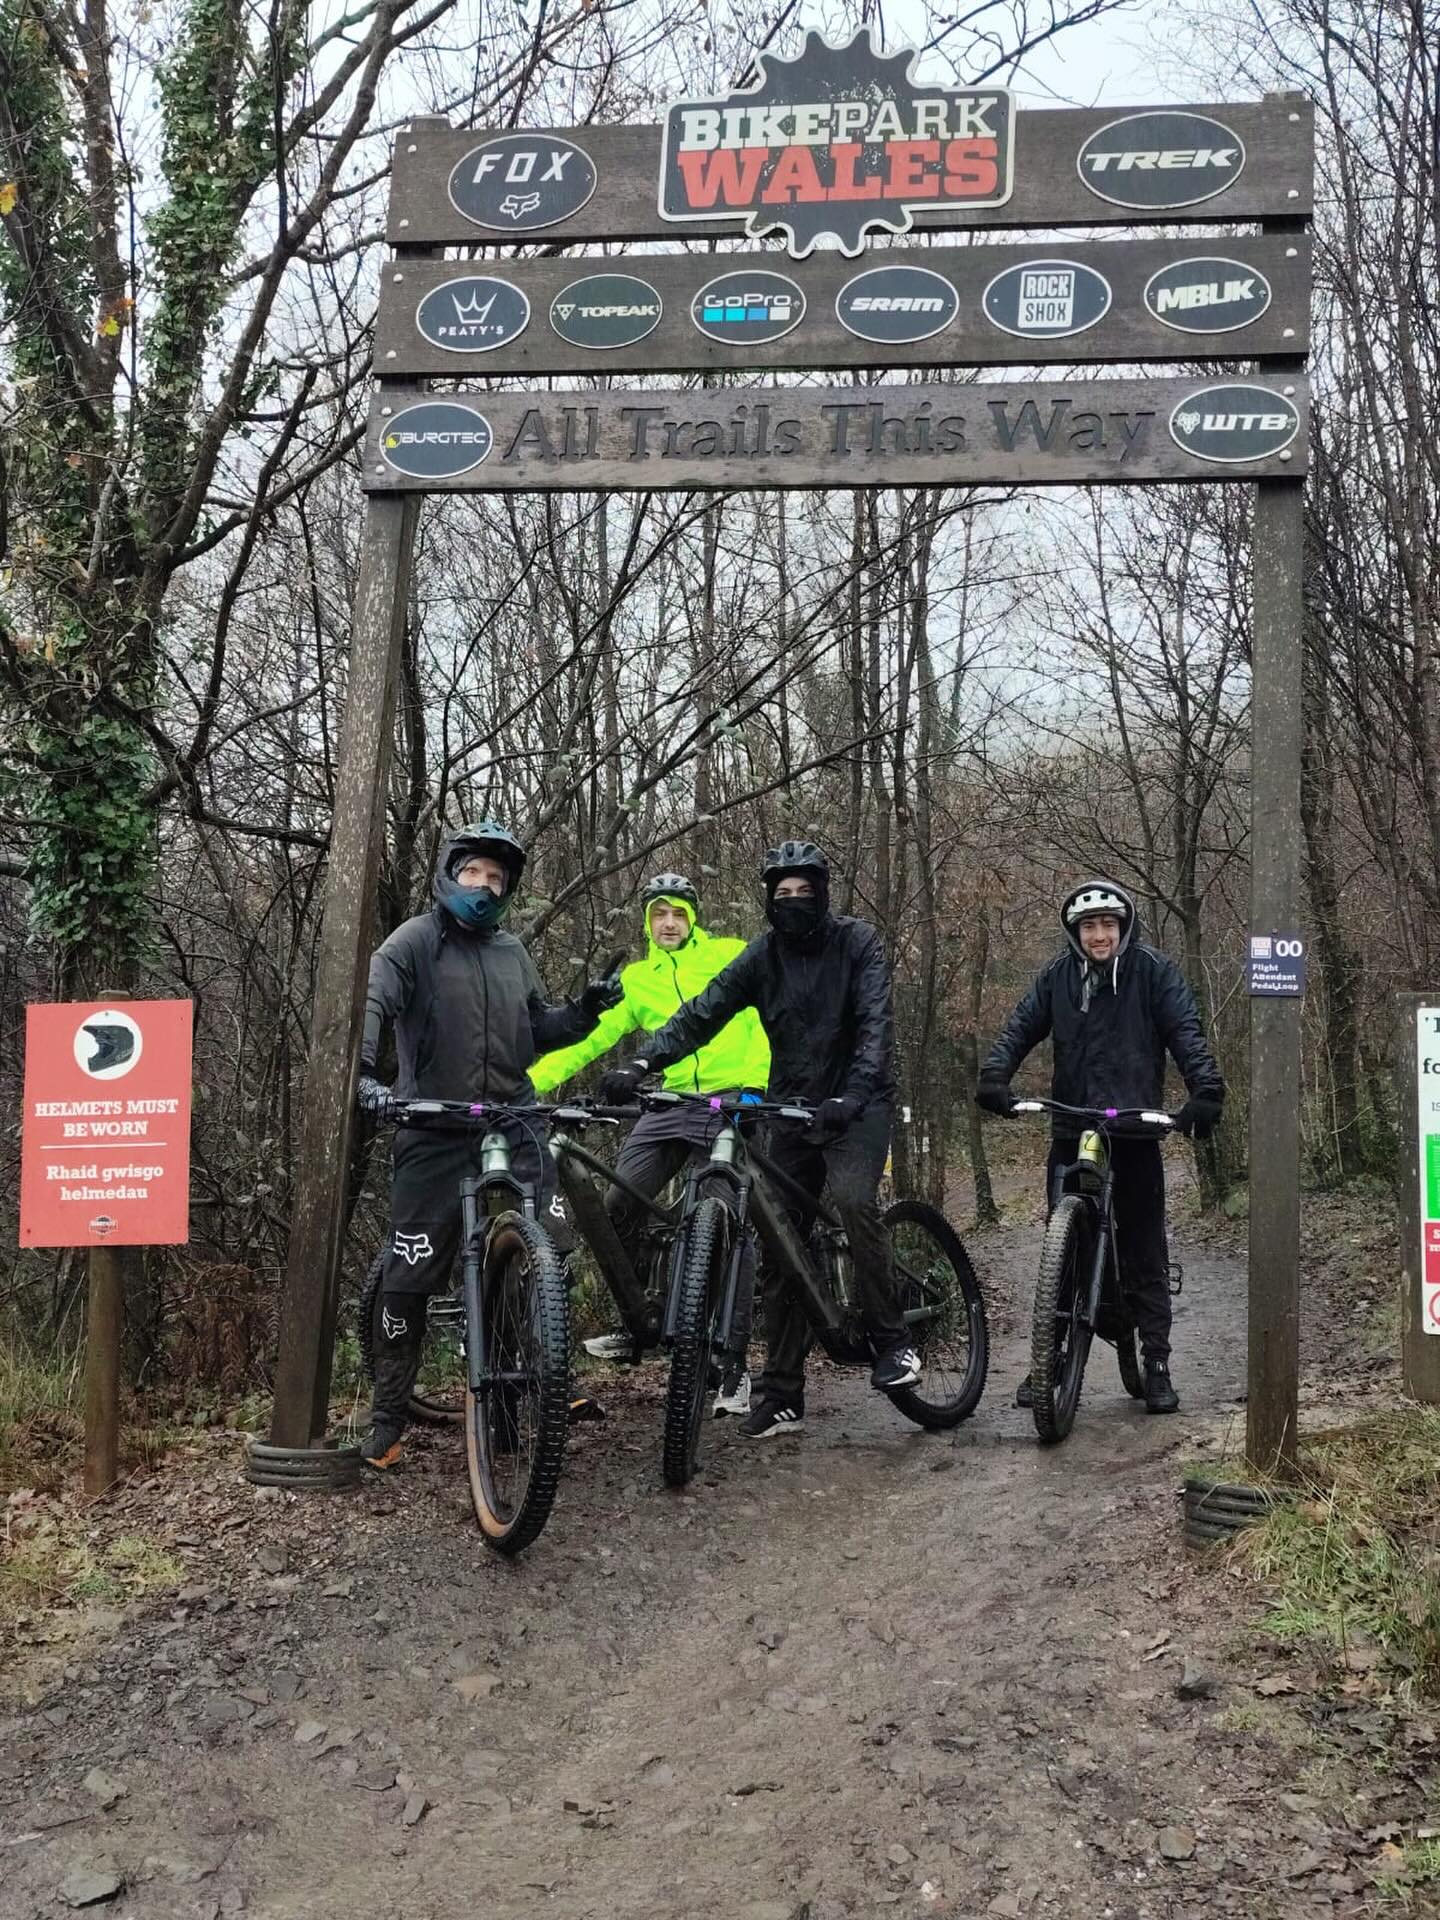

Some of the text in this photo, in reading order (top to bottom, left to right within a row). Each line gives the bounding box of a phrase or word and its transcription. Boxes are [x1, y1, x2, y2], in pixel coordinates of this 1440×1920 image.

[679, 97, 998, 150] BIKEPARK
[472, 151, 574, 183] FOX
[1086, 149, 1239, 171] TREK
[677, 138, 998, 208] WALES
[1025, 275, 1070, 298] ROCK
[703, 293, 792, 308] GoPro
[850, 297, 945, 312] SRAM
[1156, 279, 1256, 313] MBUK
[578, 304, 657, 318] TOPEAK
[1025, 302, 1067, 322] SHOX
[438, 325, 504, 337] PEATY'S
[1202, 413, 1289, 430] WTB
[401, 431, 487, 444] BURGTEC
[502, 399, 1156, 463] All Trails This Way
[1275, 940, 1303, 957] 00
[1252, 963, 1279, 973] Flight
[1252, 973, 1297, 981] Attendant
[35, 1099, 178, 1117] HELMETS MUST
[63, 1121, 149, 1137] BE WORN
[46, 1163, 164, 1182] Rhaid gwisgo
[60, 1185, 148, 1201] helmedau
